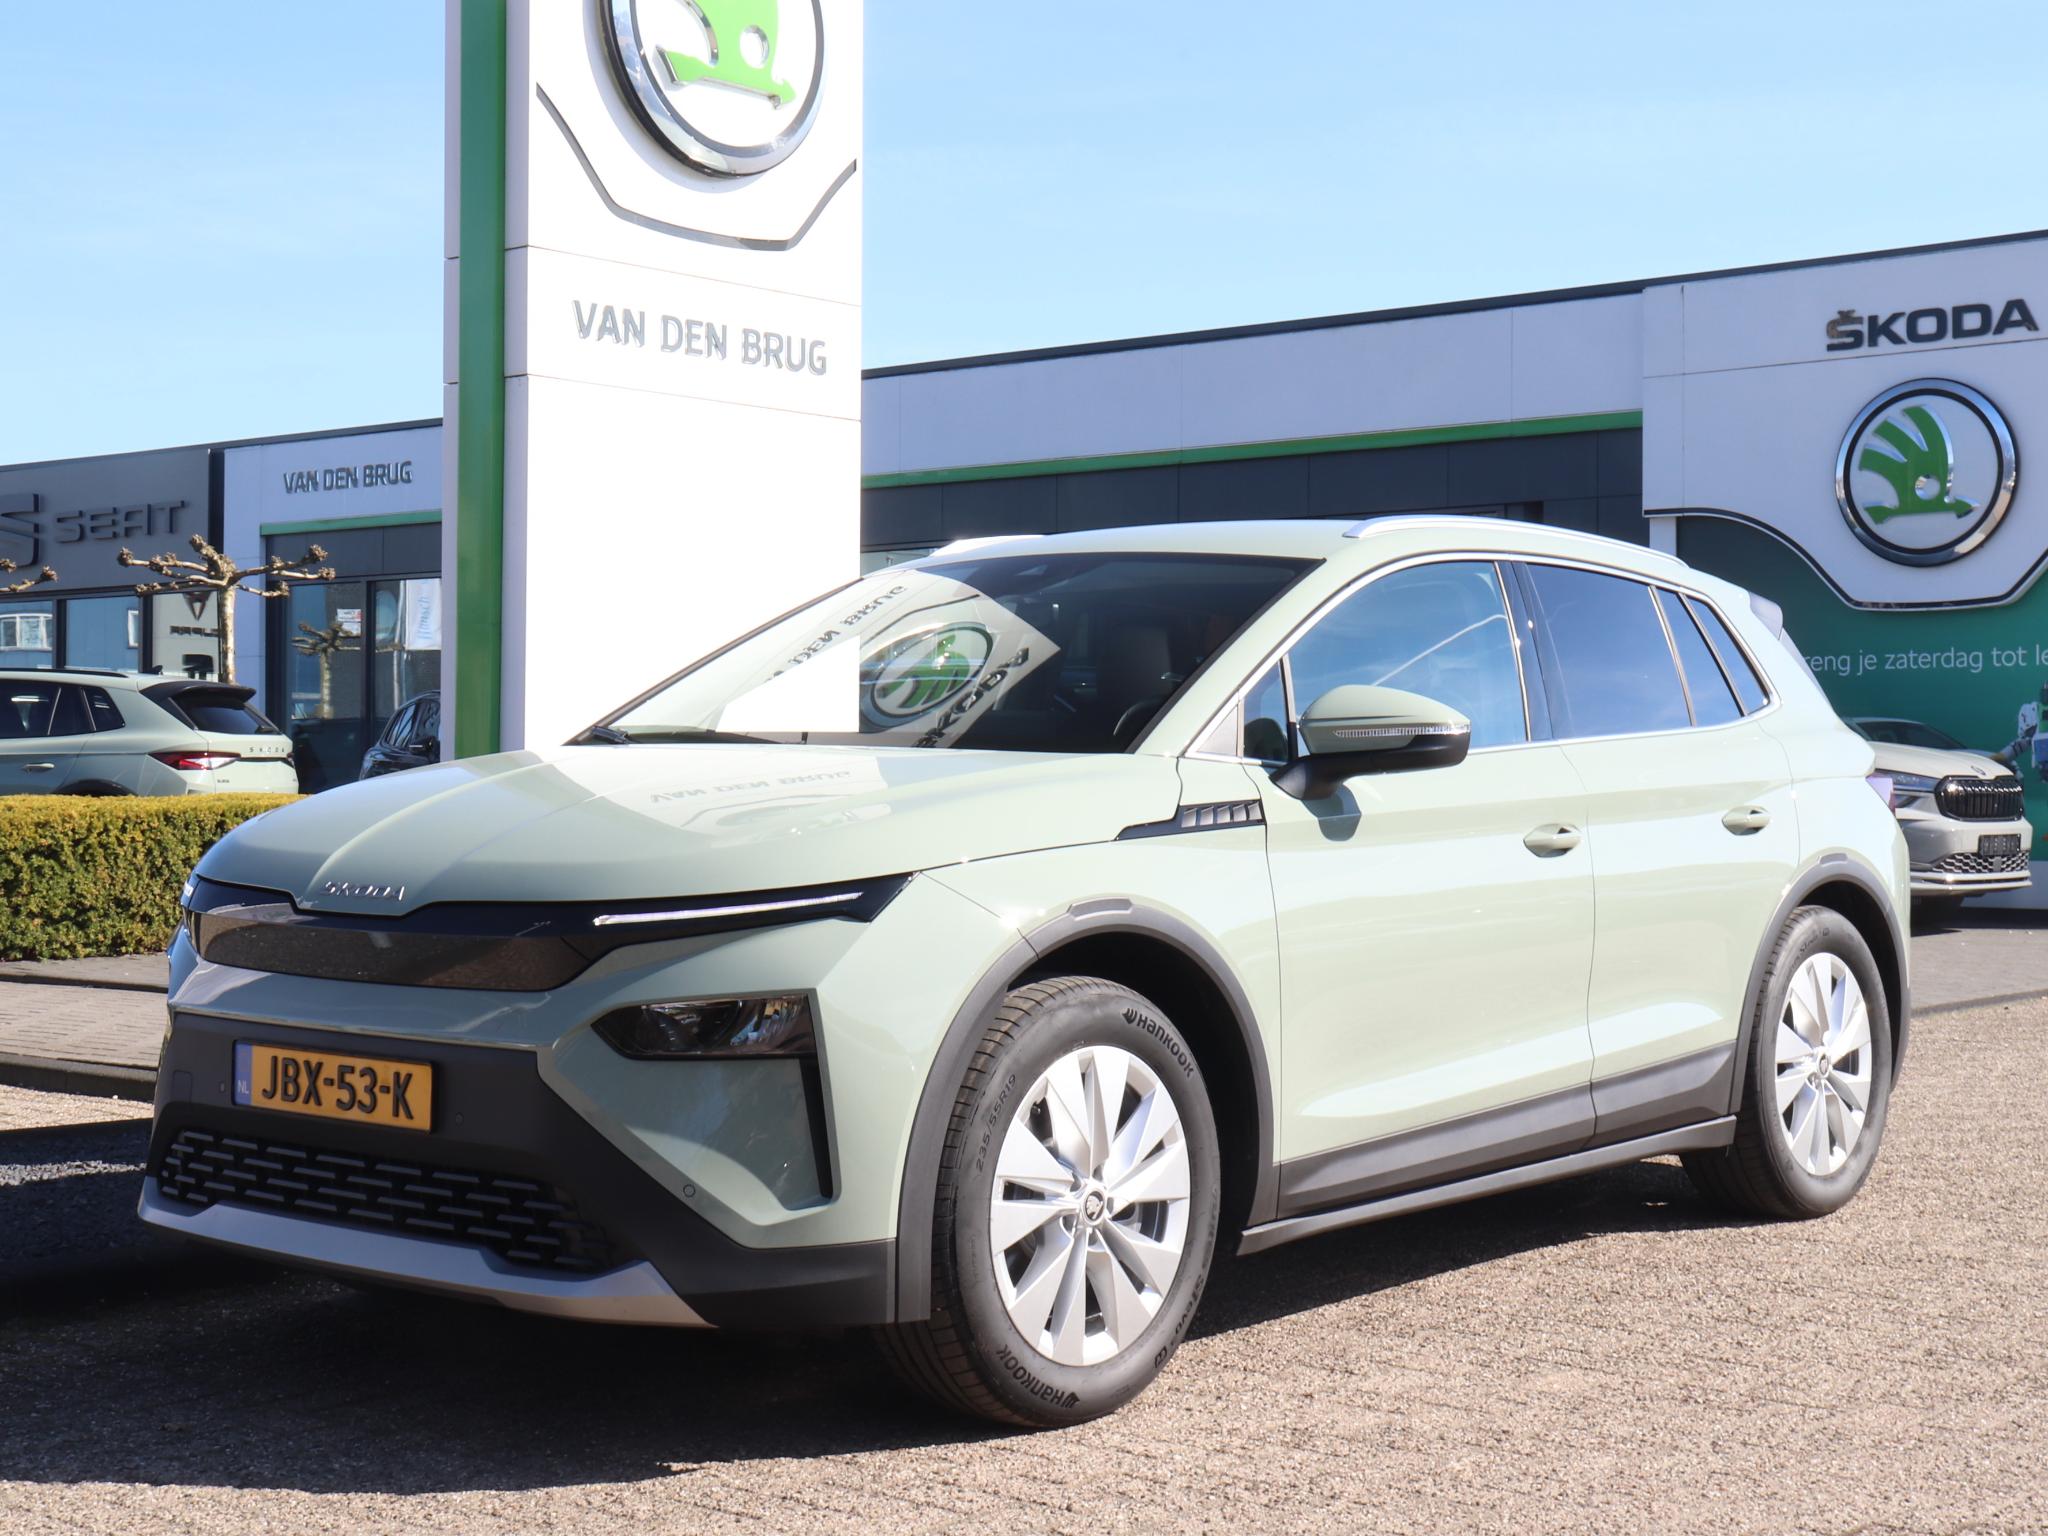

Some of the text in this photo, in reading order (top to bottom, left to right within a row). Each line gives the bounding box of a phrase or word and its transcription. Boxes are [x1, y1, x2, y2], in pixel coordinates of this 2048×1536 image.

[572, 299, 827, 376] VAN DEN BRUG
[1826, 298, 2040, 352] ŠKODA
[283, 460, 413, 494] VAN DEN BRUG
[55, 500, 187, 545] SEAT
[1857, 649, 1878, 676] je
[1884, 646, 1983, 673] zaterdag
[1990, 646, 2028, 667] tot
[238, 1079, 250, 1095] NL
[262, 1055, 414, 1120] JBX-53-K
